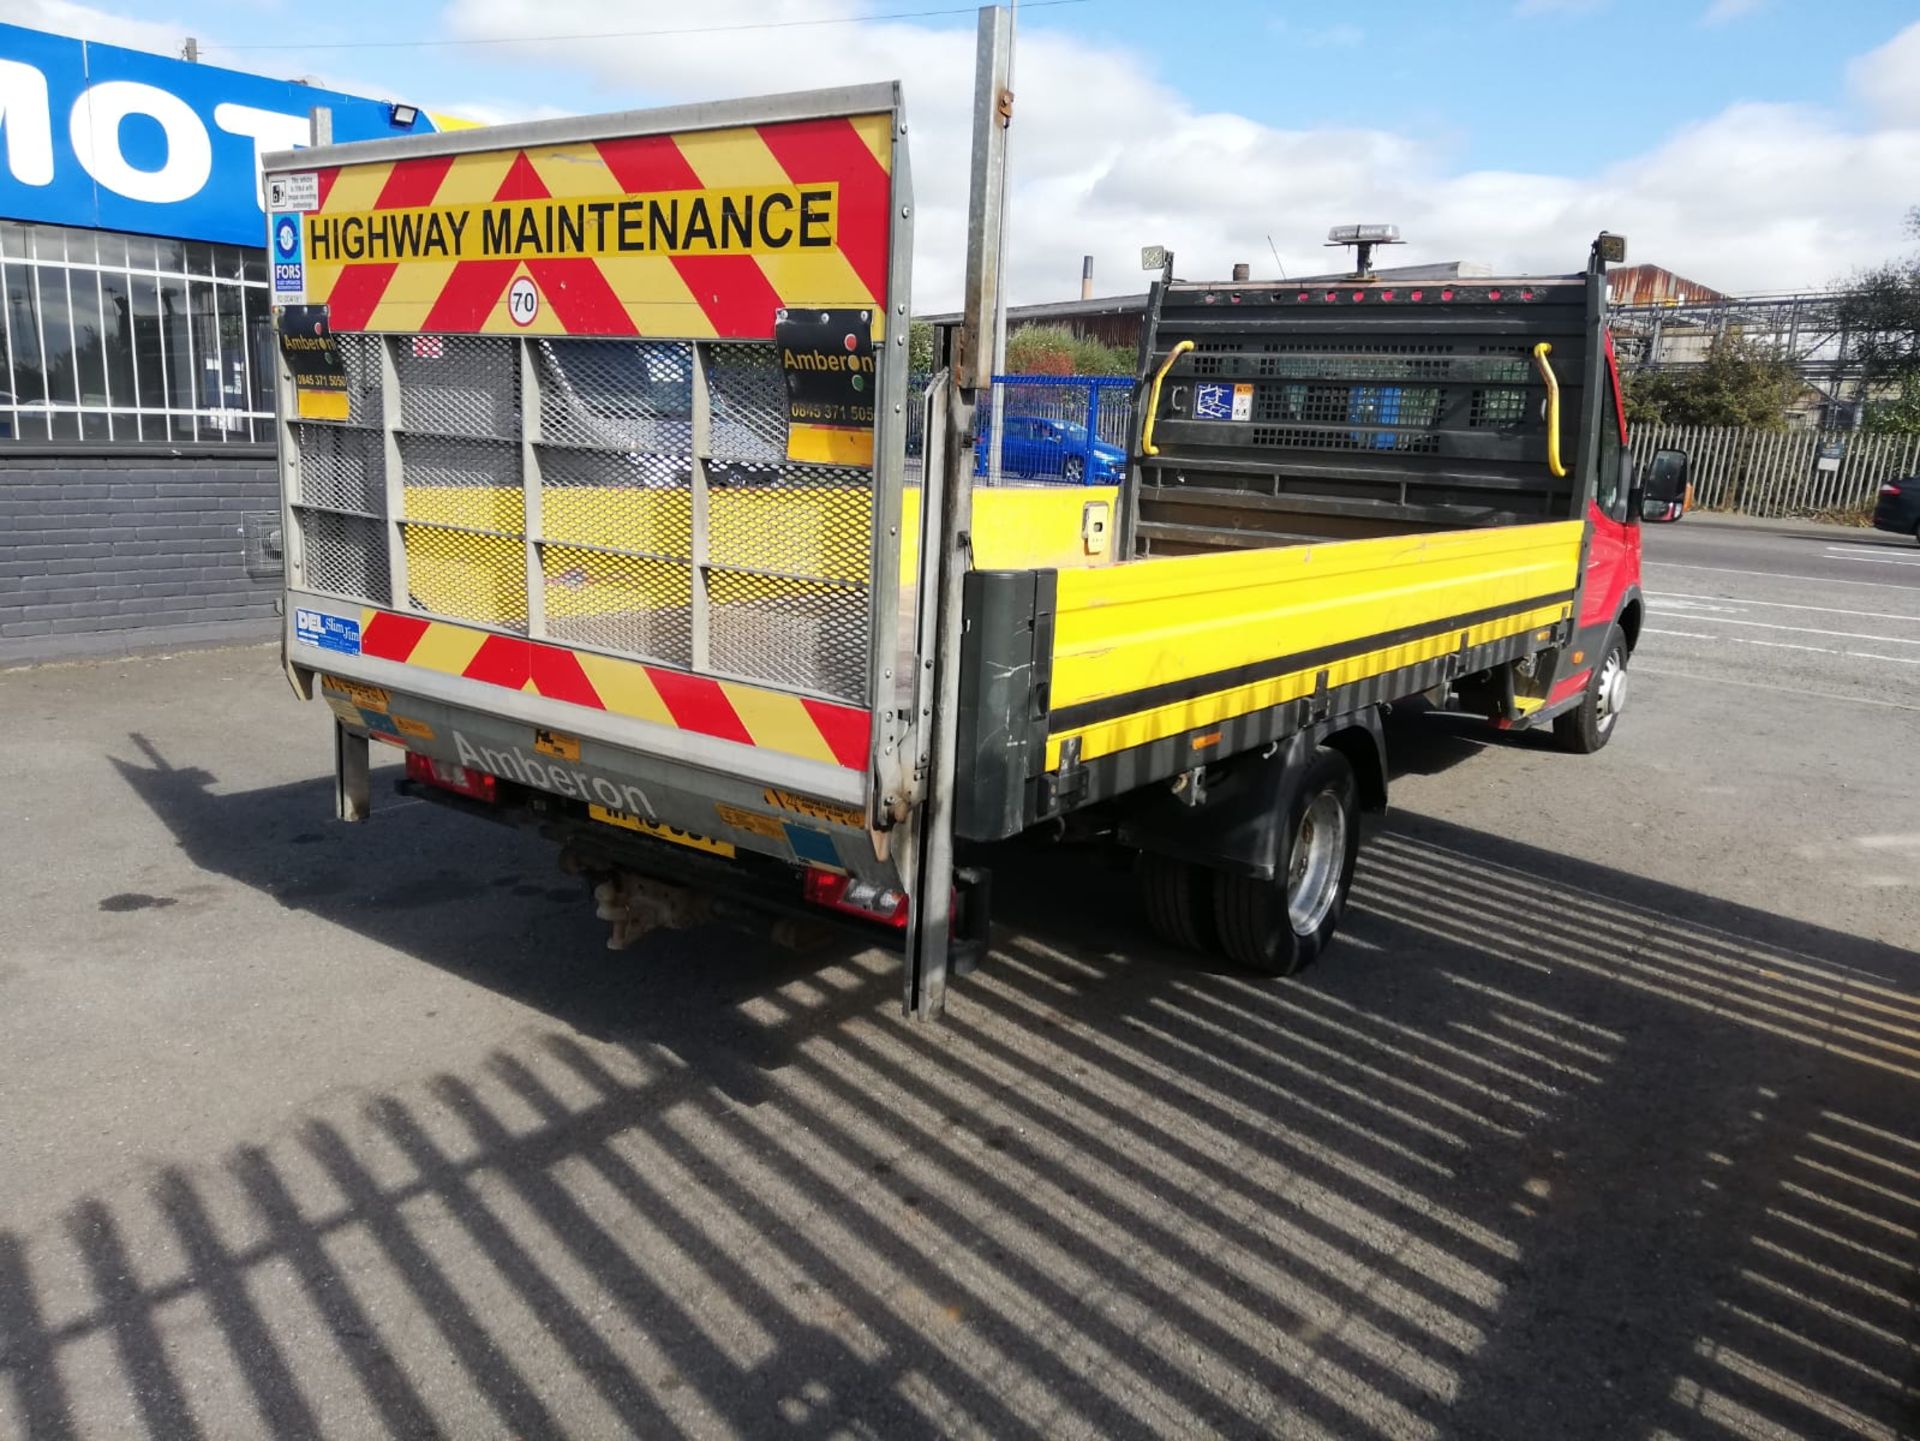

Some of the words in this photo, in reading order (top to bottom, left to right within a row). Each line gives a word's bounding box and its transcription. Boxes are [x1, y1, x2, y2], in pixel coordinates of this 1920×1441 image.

[310, 211, 470, 260] HIGHWAY
[482, 190, 832, 256] MAINTENANCE
[276, 265, 301, 279] FORS
[512, 292, 535, 313] 70
[284, 333, 336, 351] Amberon
[784, 348, 874, 373] Amberon
[824, 405, 847, 419] 371
[850, 405, 875, 421] 505
[298, 610, 326, 634] DEL
[325, 617, 344, 634] Slim
[452, 730, 657, 818] Amberon
